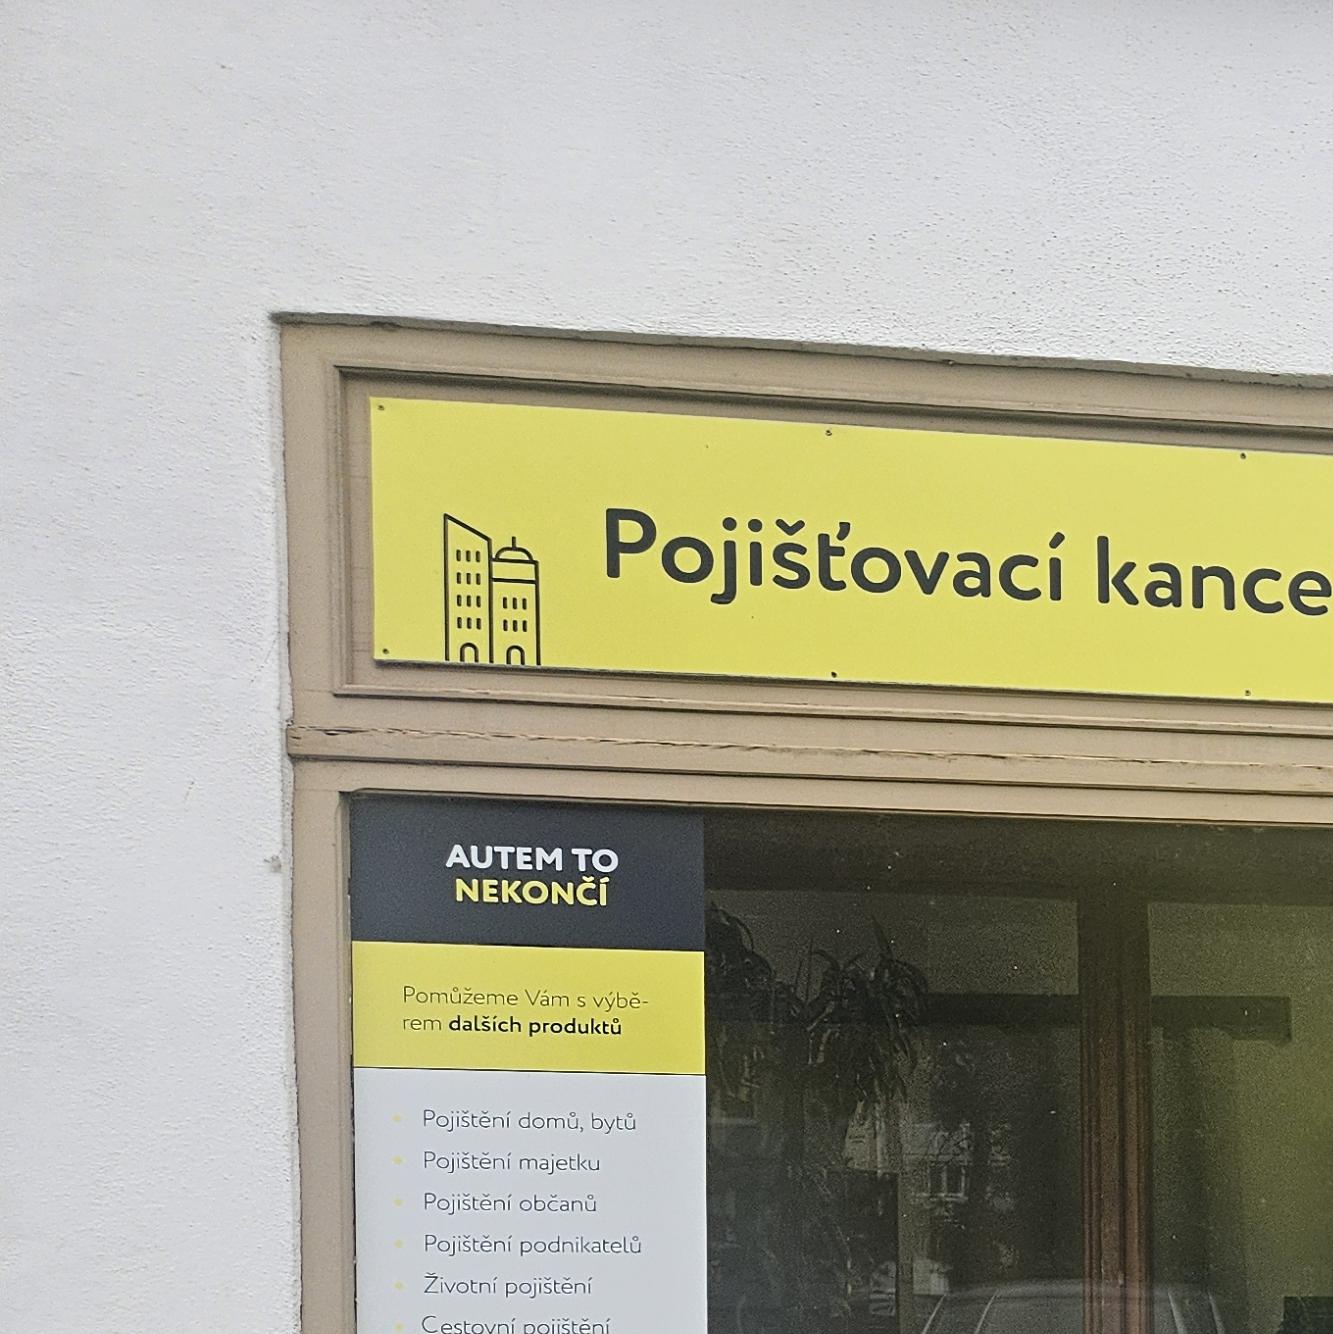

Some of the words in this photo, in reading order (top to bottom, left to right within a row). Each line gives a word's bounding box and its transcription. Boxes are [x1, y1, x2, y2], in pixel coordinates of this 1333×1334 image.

[601, 507, 1066, 606] Pojišťovací
[446, 844, 563, 872] AUTEM
[572, 848, 620, 873] TO
[455, 876, 609, 906] NEKONČÍ
[403, 985, 519, 1008] Pomůžeme
[525, 988, 570, 1008] Vám
[577, 995, 587, 1009] s
[593, 987, 649, 1013] výbě-
[403, 1016, 442, 1032] rem
[448, 1014, 522, 1034] dalších
[528, 1016, 623, 1038] produktů
[422, 1109, 512, 1133] Pojištění
[518, 1111, 585, 1134] domů,
[590, 1110, 637, 1134] bytů
[423, 1151, 512, 1173] Pojištění
[519, 1155, 600, 1175] majetku
[424, 1192, 512, 1215] Pojištění
[519, 1193, 598, 1213] občanů
[424, 1234, 512, 1257] Pojištění
[520, 1233, 643, 1258] podnikatelů
[424, 1273, 498, 1296] Životní
[505, 1277, 594, 1299] pojištění
